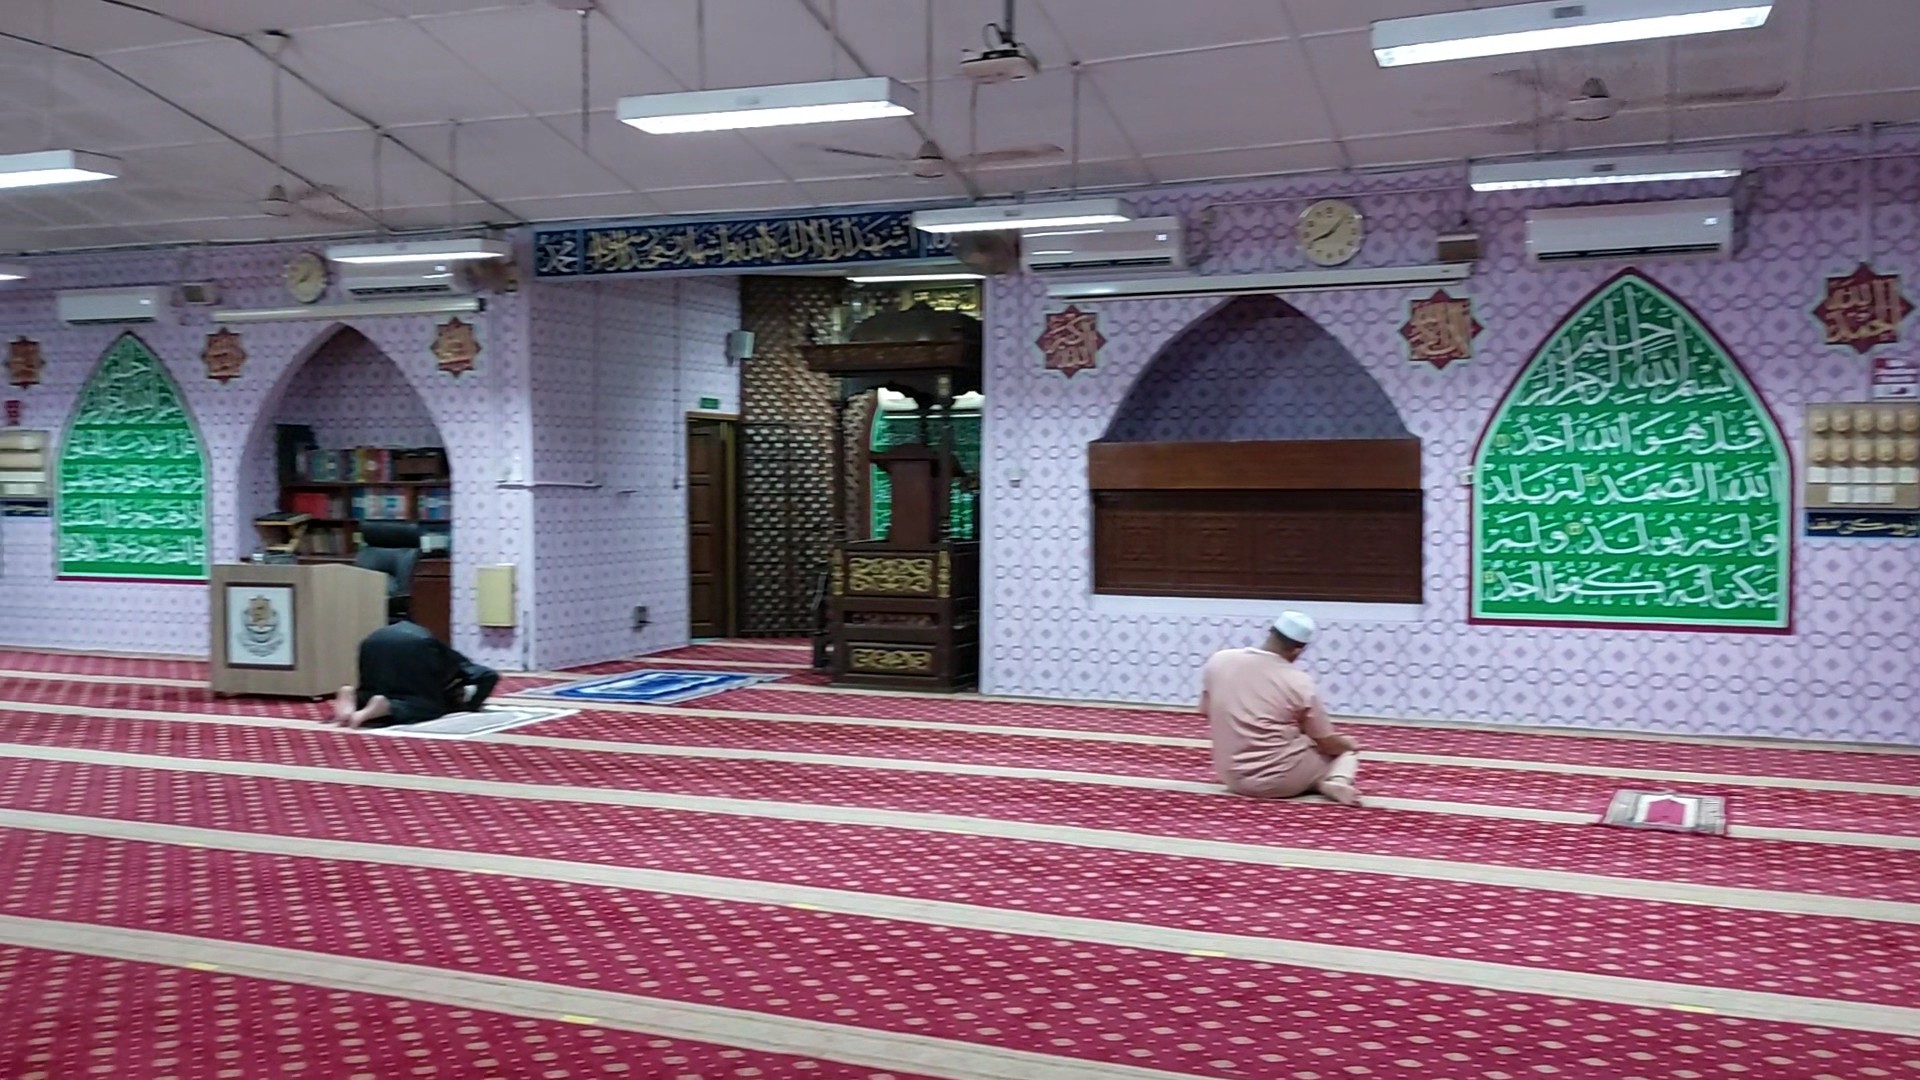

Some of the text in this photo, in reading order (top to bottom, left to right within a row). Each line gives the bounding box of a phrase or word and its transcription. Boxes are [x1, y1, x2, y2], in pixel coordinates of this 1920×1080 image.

[1650, 367, 1735, 405] بسم
[1511, 410, 1765, 455] قل هو الله أحد
[1483, 462, 1556, 504] يلد
[1591, 462, 1719, 504] الصمد
[1721, 462, 1781, 504] الله
[1480, 511, 1779, 557] ولم يولد ولم
[1543, 562, 1667, 605] كفوا
[1659, 563, 1713, 606] له
[1711, 564, 1779, 609] يكن
